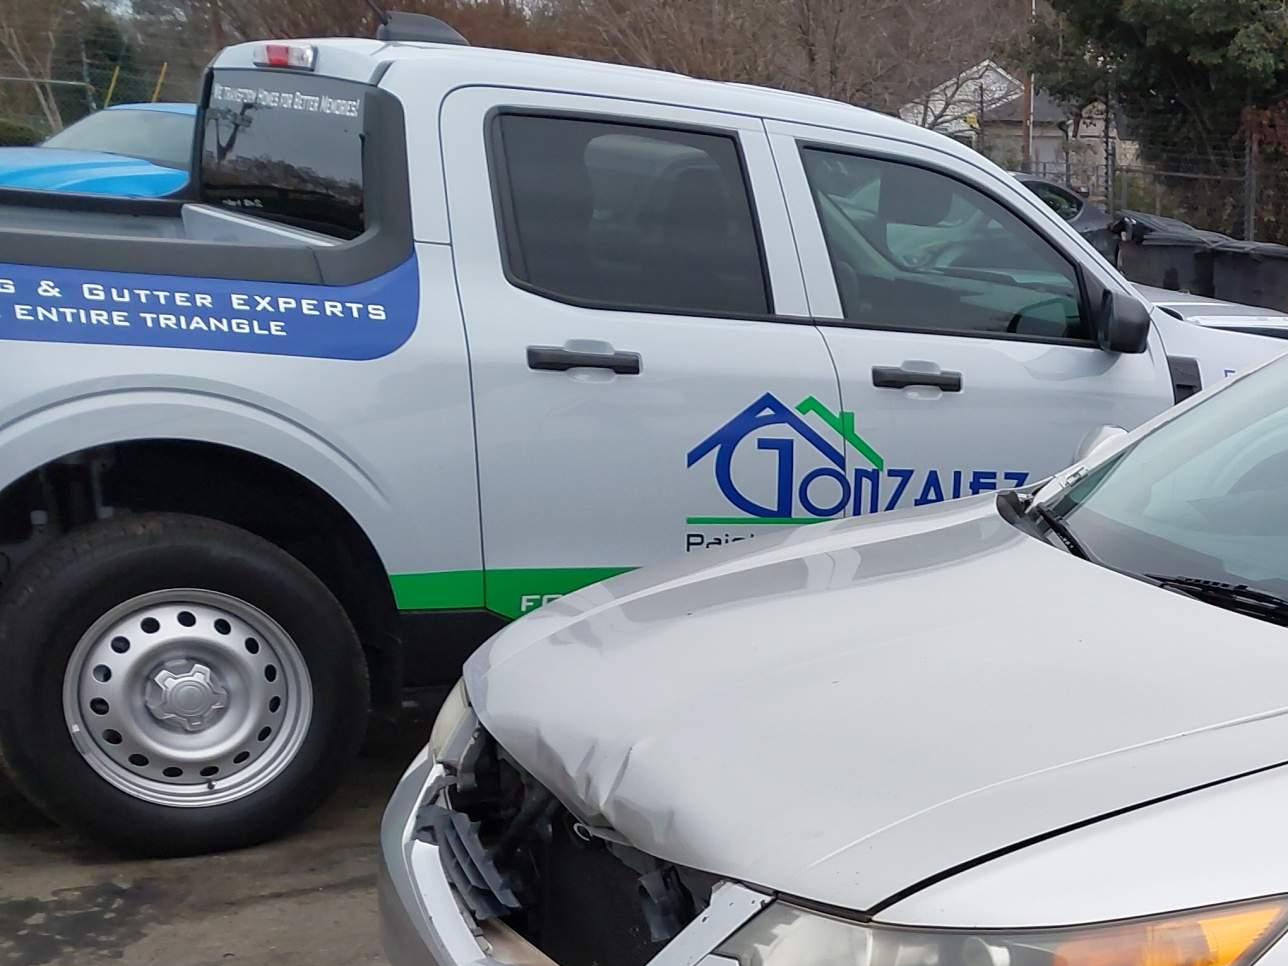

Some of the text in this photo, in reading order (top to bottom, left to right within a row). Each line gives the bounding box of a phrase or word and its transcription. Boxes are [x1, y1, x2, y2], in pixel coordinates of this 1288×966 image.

[37, 280, 62, 298] &
[82, 283, 213, 308] GUTTER
[230, 293, 387, 320] EXPERTS
[14, 304, 287, 336] ENTIRE TRIANGLE
